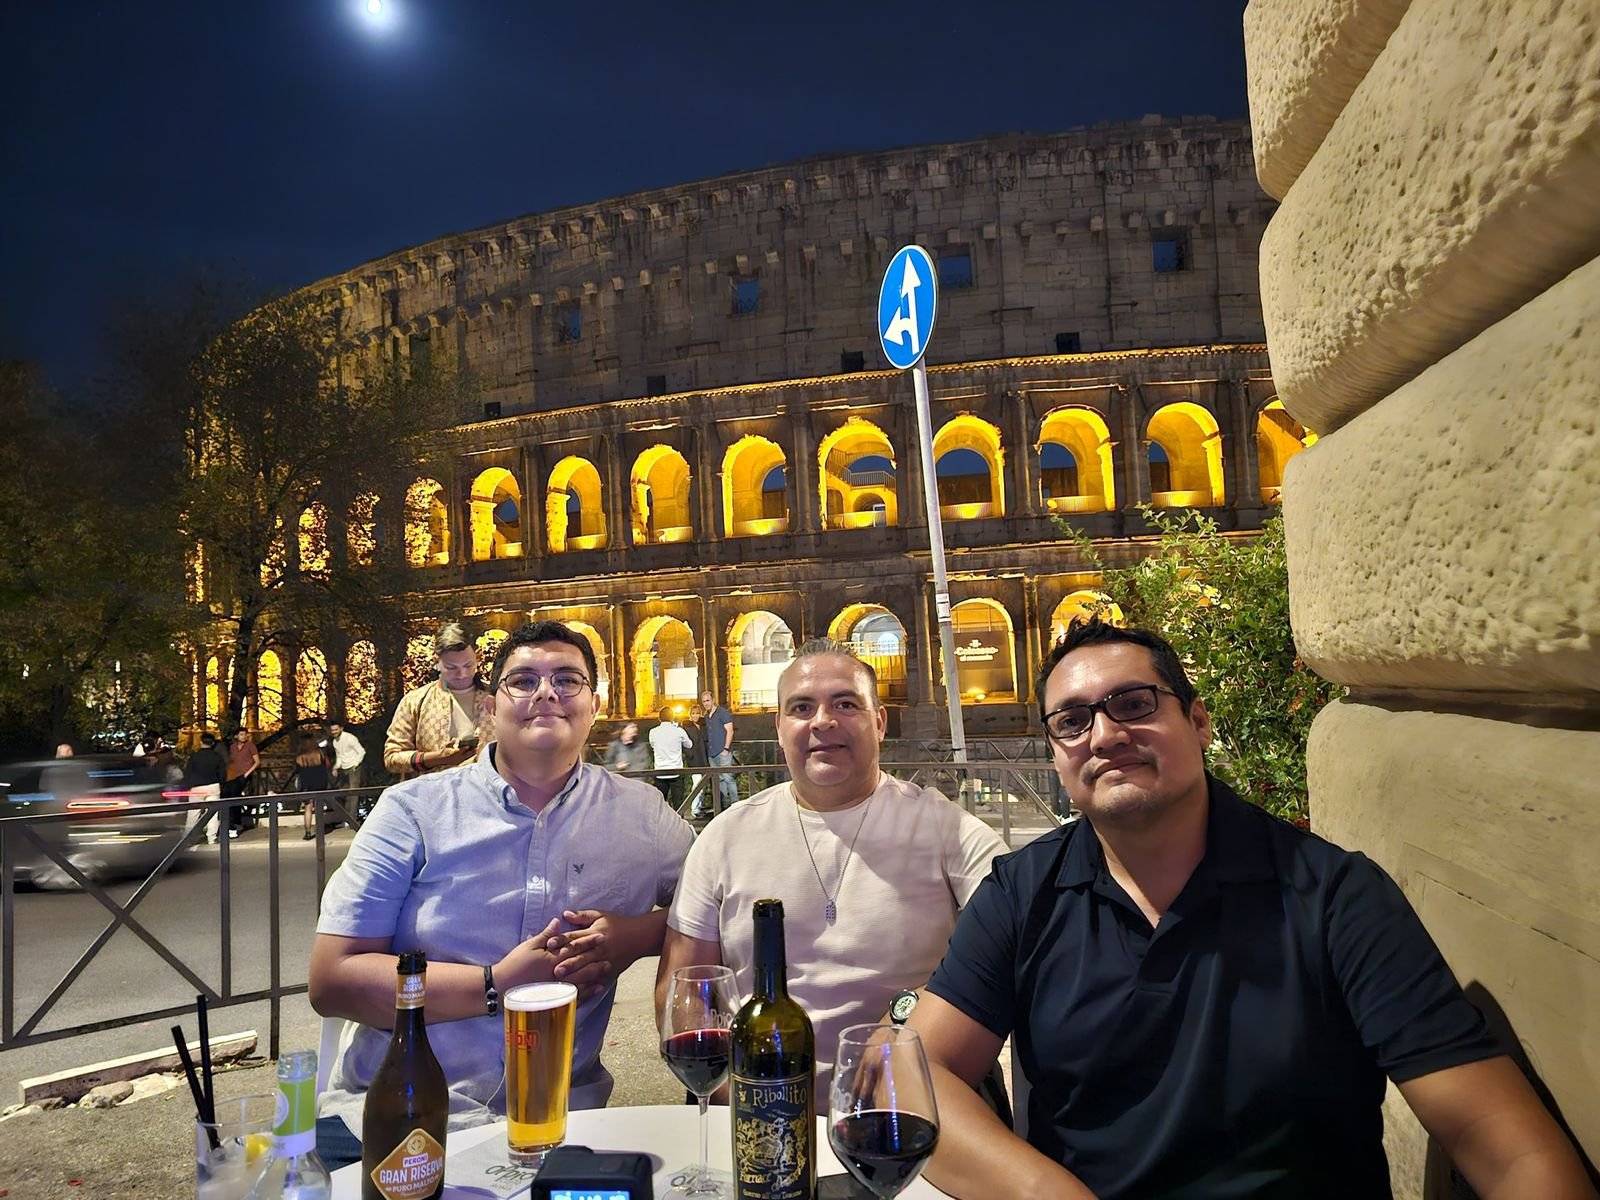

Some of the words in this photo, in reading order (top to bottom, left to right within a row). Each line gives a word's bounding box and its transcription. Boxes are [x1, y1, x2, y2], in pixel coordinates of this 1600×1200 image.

[752, 1085, 807, 1109] Ribollito
[404, 1154, 426, 1166] PERONI
[380, 1169, 408, 1184] GRAN
[411, 1157, 443, 1182] RISERVA
[392, 1184, 412, 1193] PURO
[413, 1177, 434, 1189] MALTO
